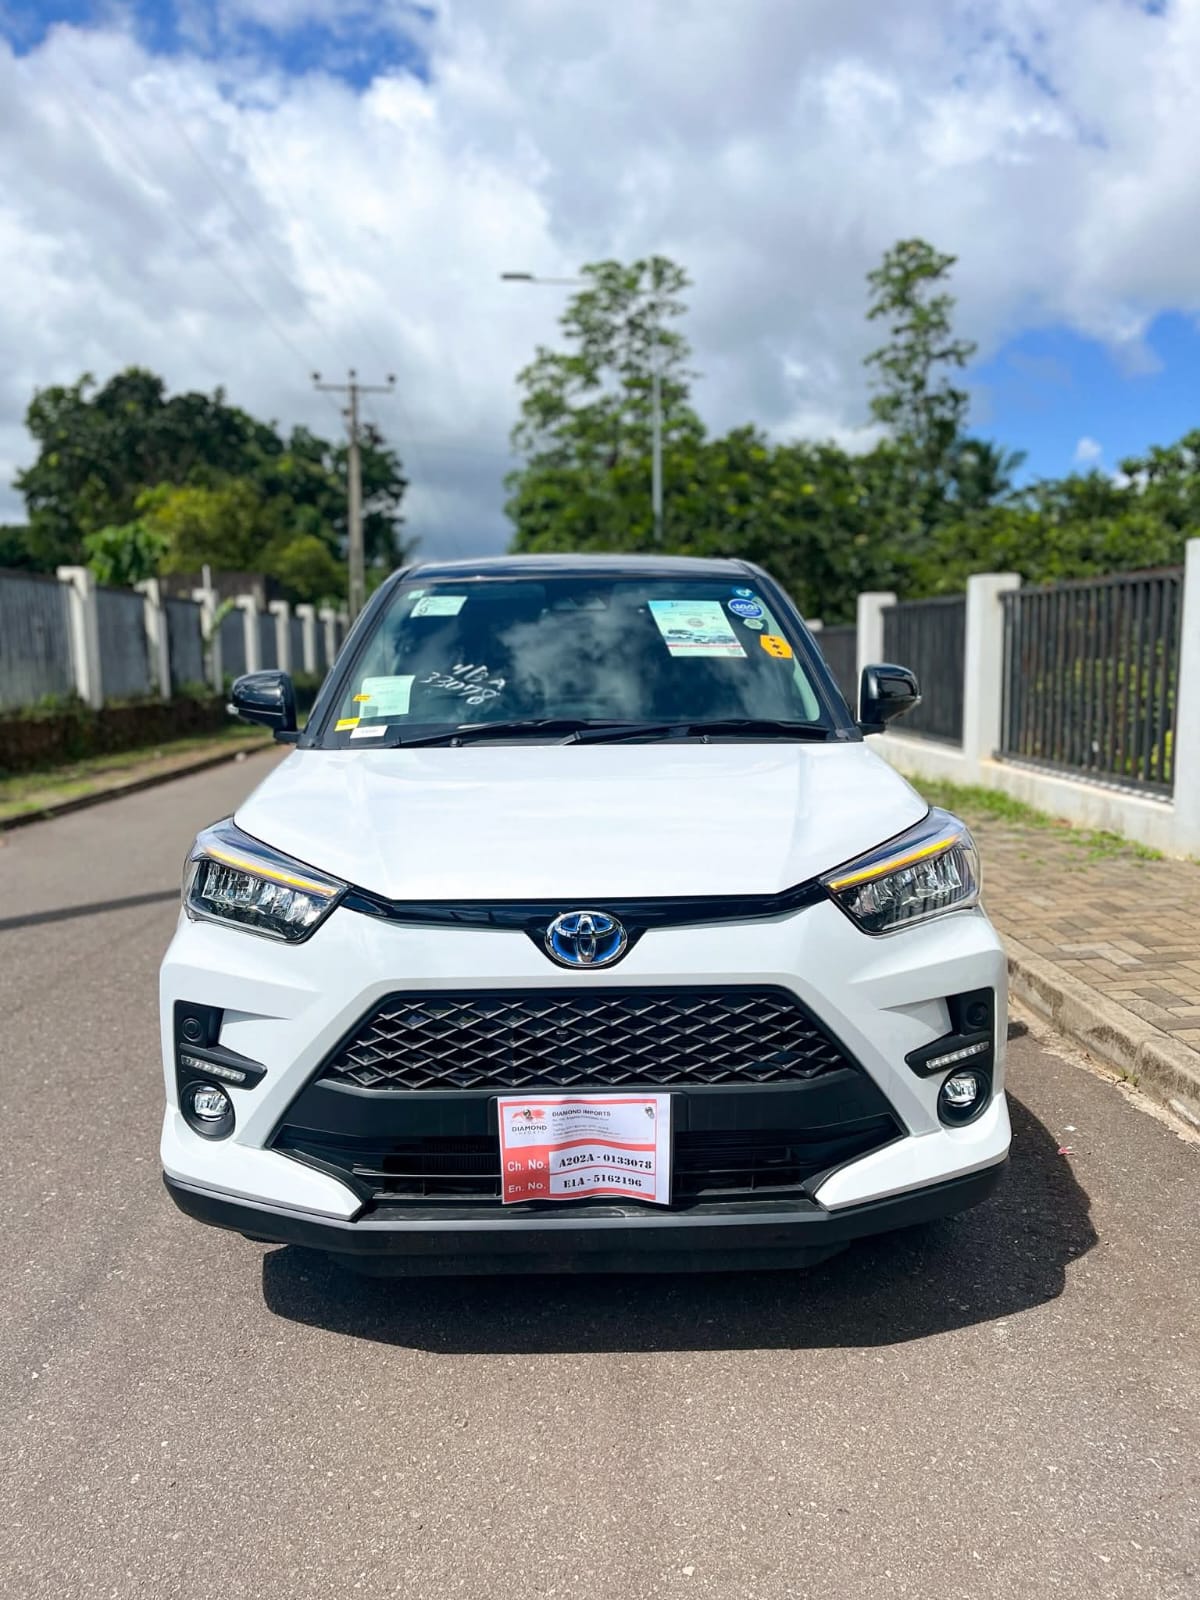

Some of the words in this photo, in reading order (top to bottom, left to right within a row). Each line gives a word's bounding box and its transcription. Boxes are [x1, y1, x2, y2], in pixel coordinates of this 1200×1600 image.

[552, 1109, 581, 1117] DIAMOND
[511, 1124, 547, 1132] DIAMOND
[507, 1161, 524, 1172] Ch.
[528, 1159, 547, 1169] No.
[508, 1184, 524, 1193] En.
[528, 1182, 546, 1190] No.
